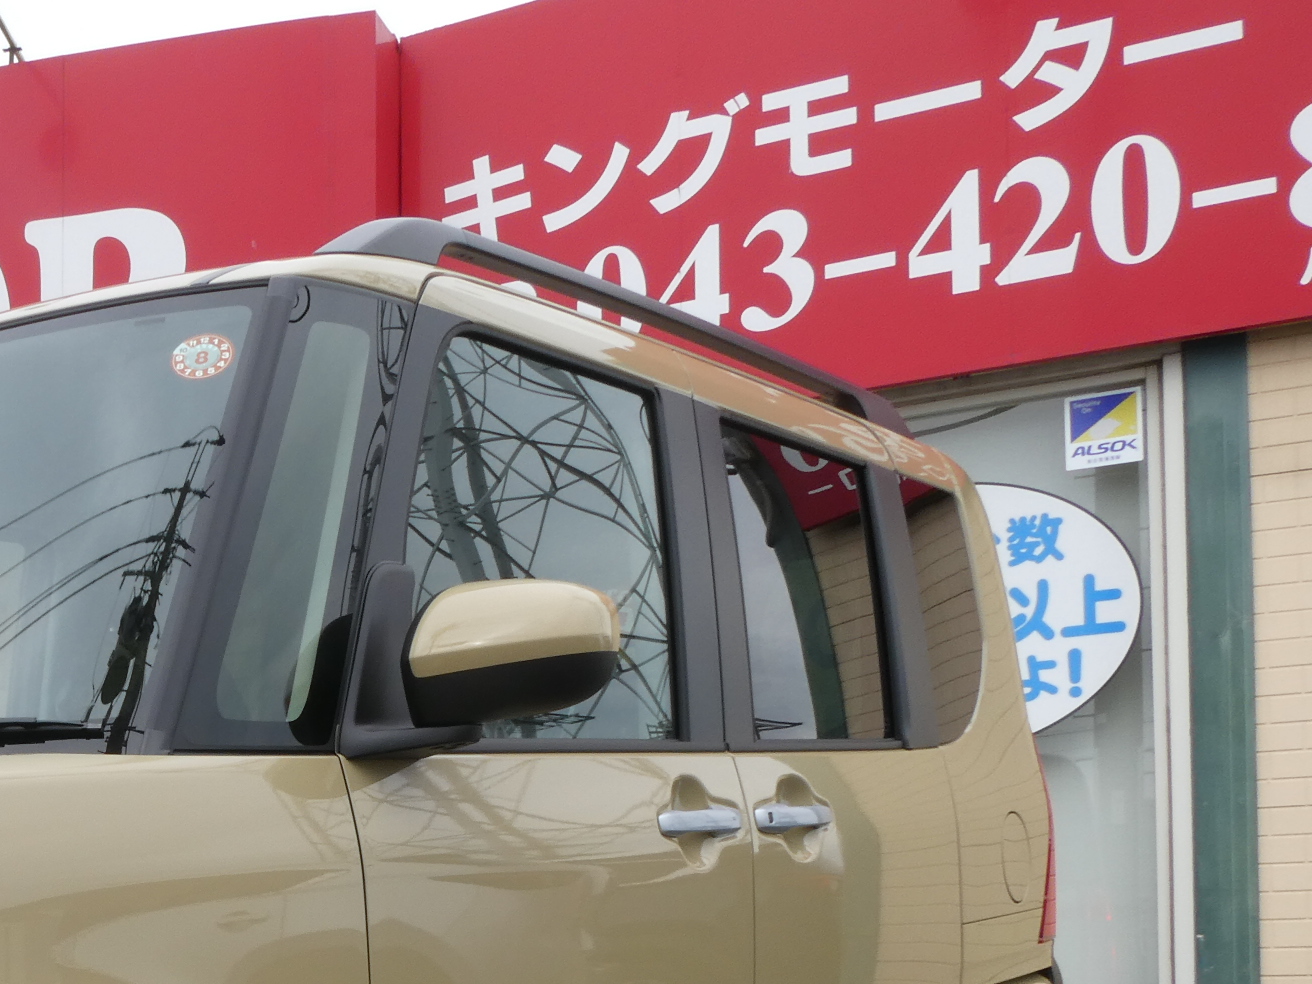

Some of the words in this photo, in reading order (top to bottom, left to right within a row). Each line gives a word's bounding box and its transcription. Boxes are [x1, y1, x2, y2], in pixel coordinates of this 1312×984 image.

[441, 16, 1245, 242] キングモーター
[194, 350, 210, 365] 8
[1071, 438, 1138, 459] ALSOK
